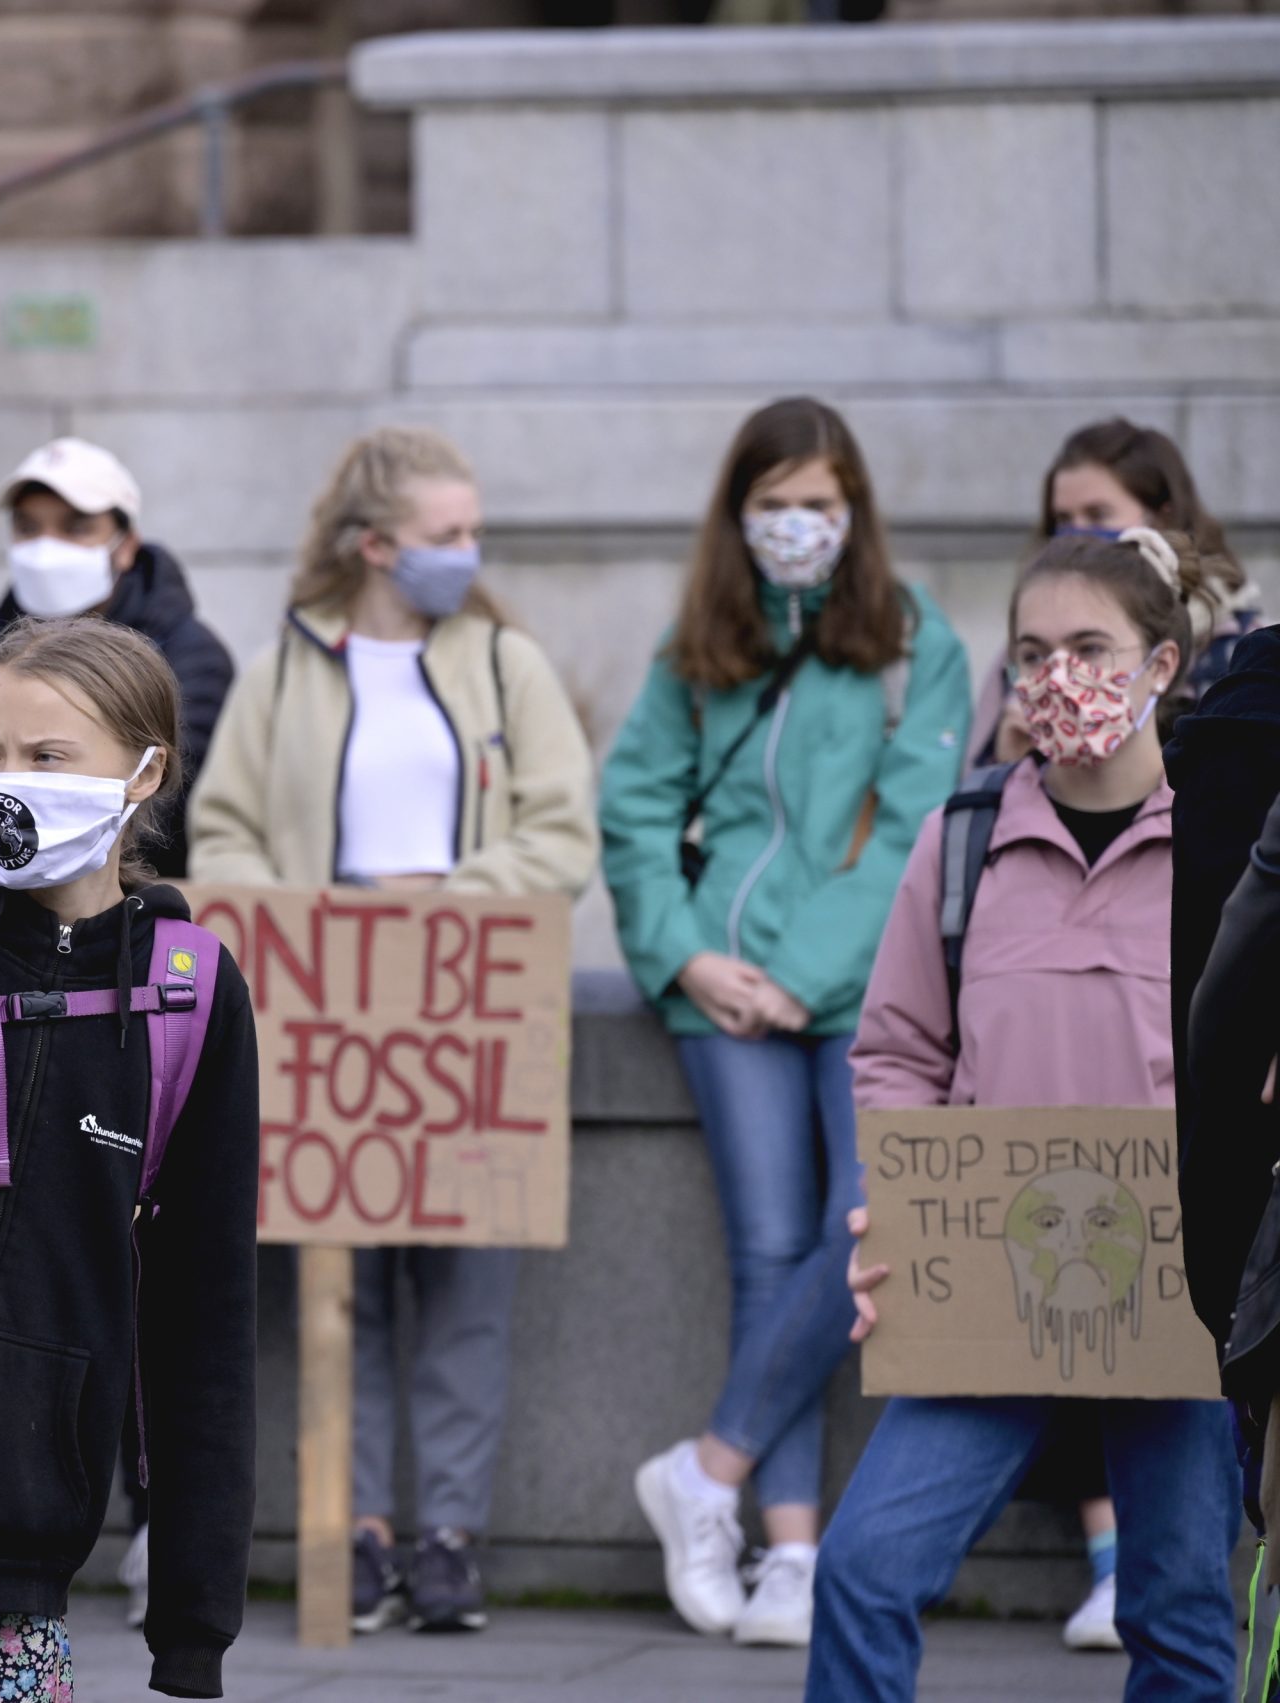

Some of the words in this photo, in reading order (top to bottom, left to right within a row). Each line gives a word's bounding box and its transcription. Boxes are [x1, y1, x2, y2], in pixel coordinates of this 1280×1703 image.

[195, 891, 411, 1014] ON'T
[419, 908, 535, 1022] BE
[277, 1021, 549, 1135] FOSSIL
[94, 1126, 143, 1149] HundarUtanHe
[877, 1131, 985, 1182] STOP
[1003, 1137, 1179, 1180] DENYIN
[258, 1122, 467, 1232] FOOL
[908, 1197, 1009, 1240] THE
[910, 1256, 953, 1303] IS
